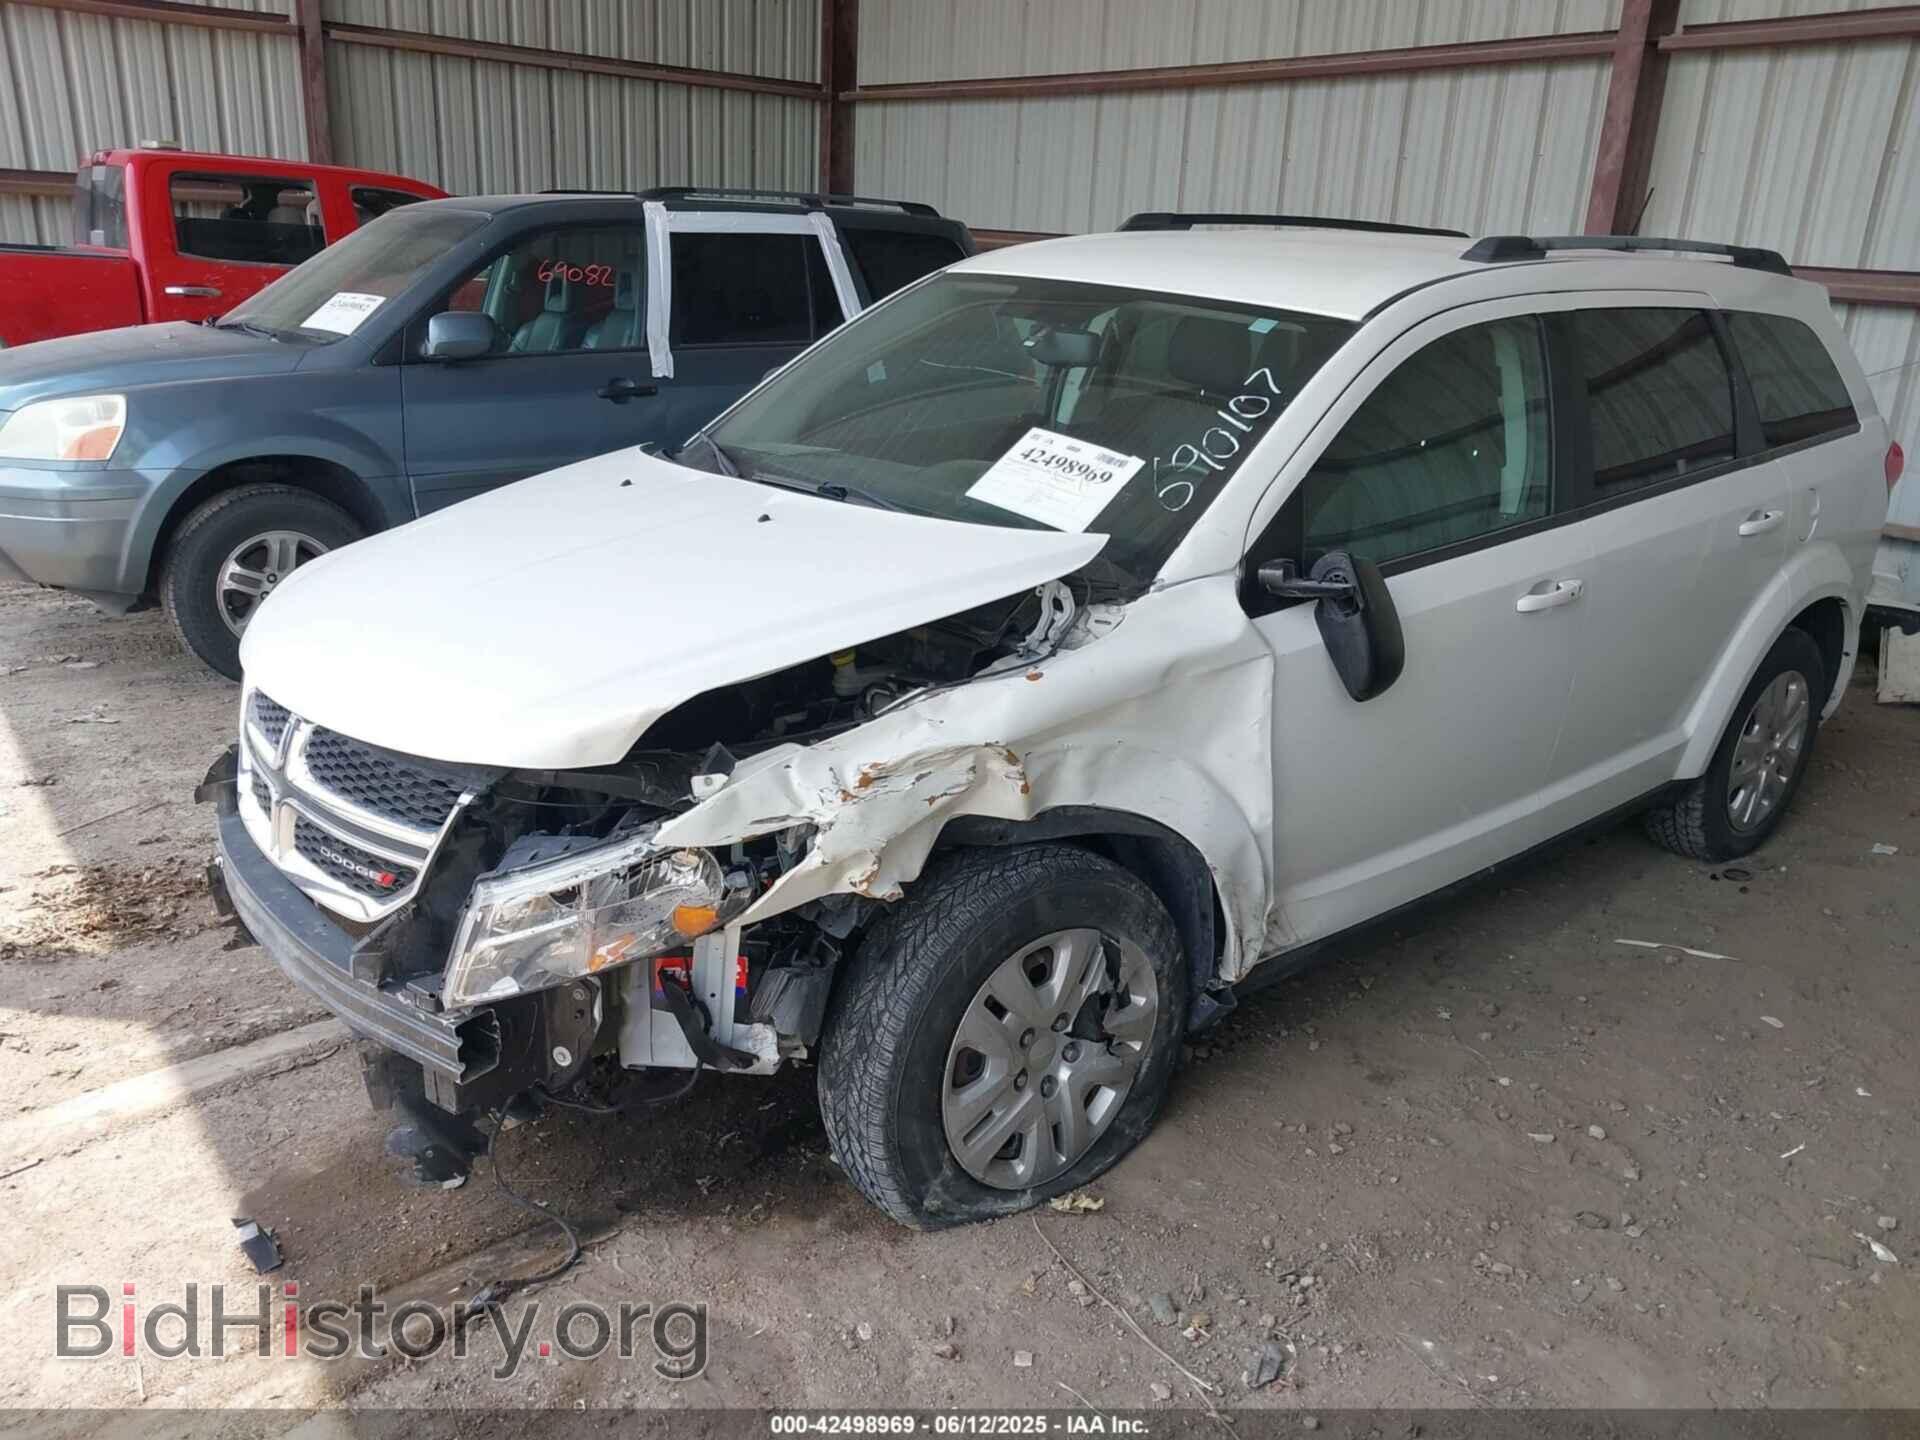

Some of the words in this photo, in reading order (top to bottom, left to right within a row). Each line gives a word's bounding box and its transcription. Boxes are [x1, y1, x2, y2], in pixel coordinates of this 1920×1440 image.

[537, 257, 616, 287] 69082
[1020, 447, 1114, 484] 42498969
[320, 845, 381, 881] DODGE
